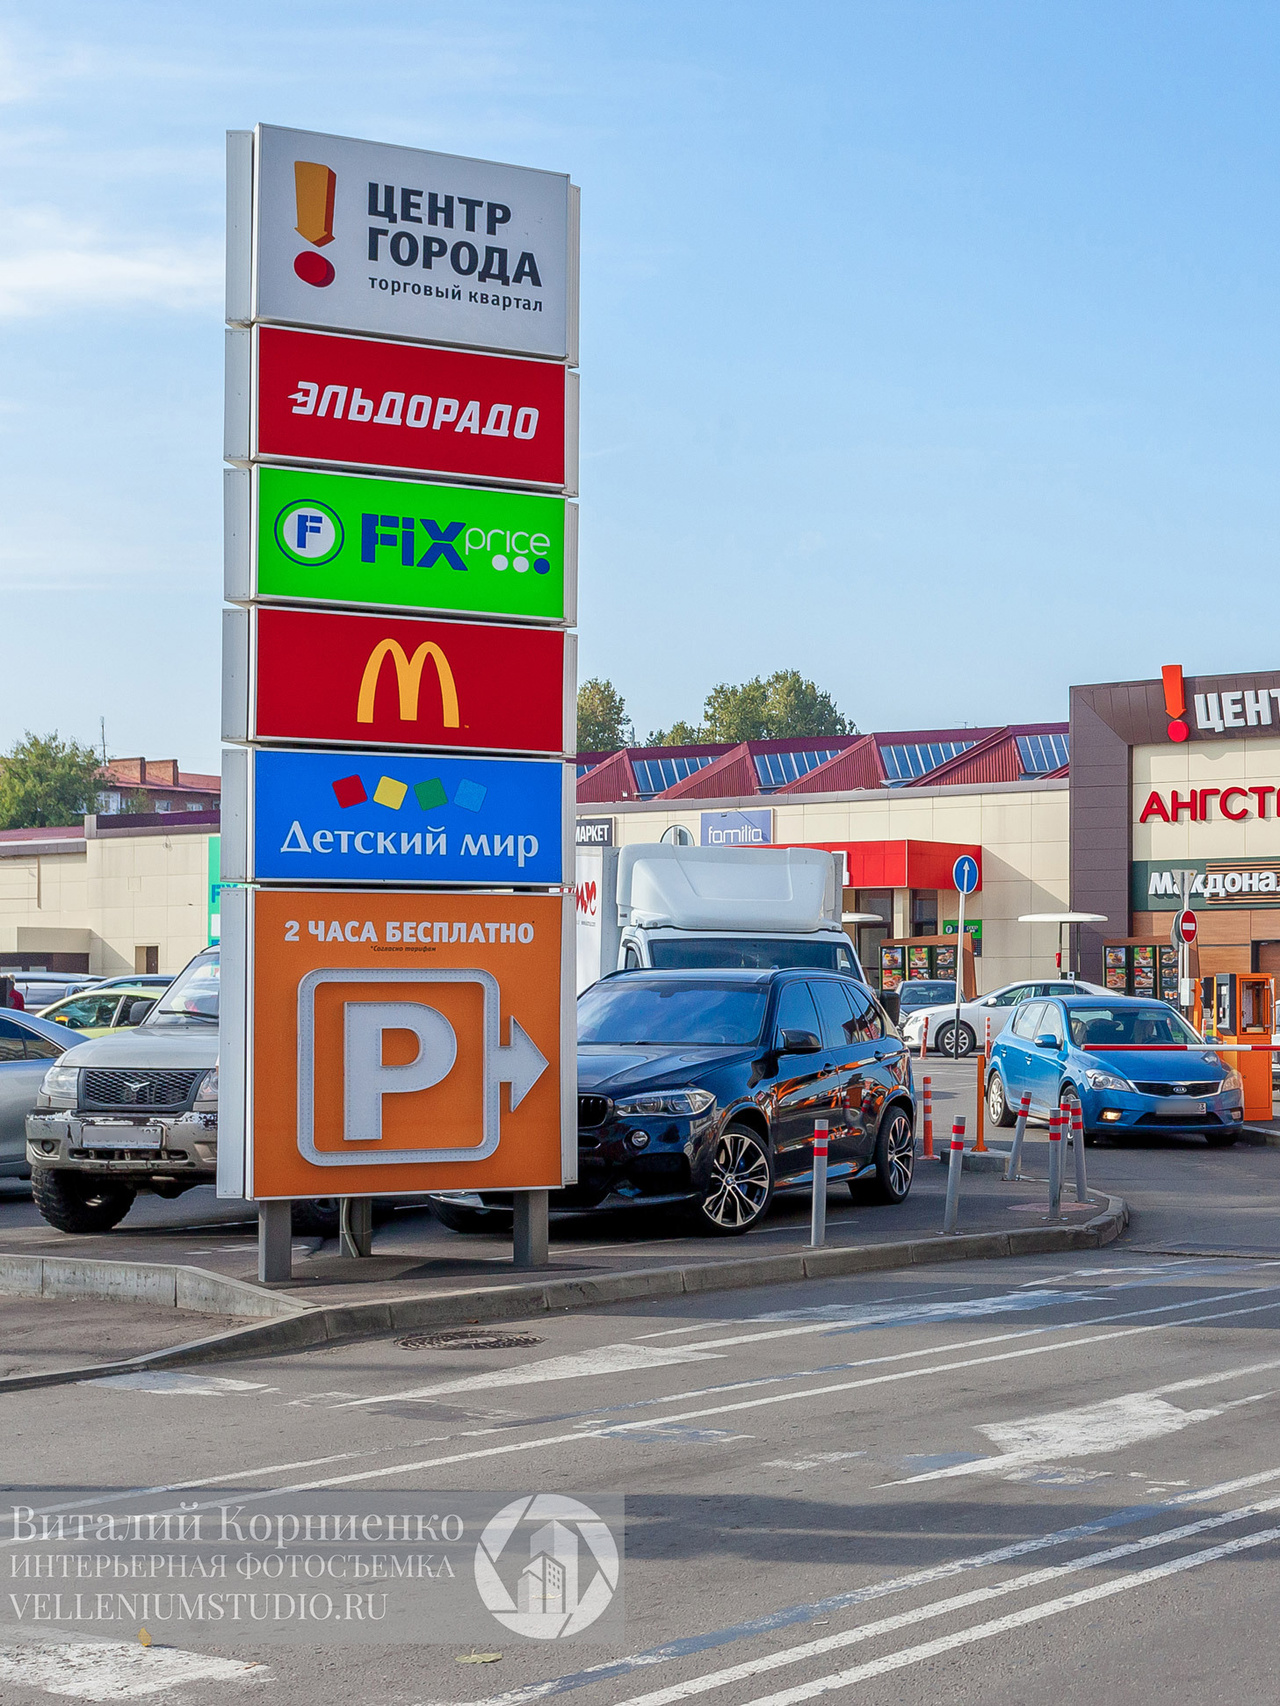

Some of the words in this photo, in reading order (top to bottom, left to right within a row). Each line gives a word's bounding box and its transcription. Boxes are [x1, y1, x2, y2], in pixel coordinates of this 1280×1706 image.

[367, 181, 512, 236] ЦЕНТР
[367, 227, 542, 287] ГОРОДА
[368, 276, 462, 301] торговый
[468, 291, 543, 313] квартал
[288, 381, 540, 440] ЭЛЬДОРАДО
[465, 527, 550, 556] price
[280, 820, 448, 857] Детский
[460, 833, 540, 868] мир
[708, 825, 763, 844] familia
[284, 921, 300, 942] 2
[308, 920, 378, 943] ЧАСА
[386, 921, 535, 944] БЕСПЛАТНО
[343, 1001, 457, 1142] P
